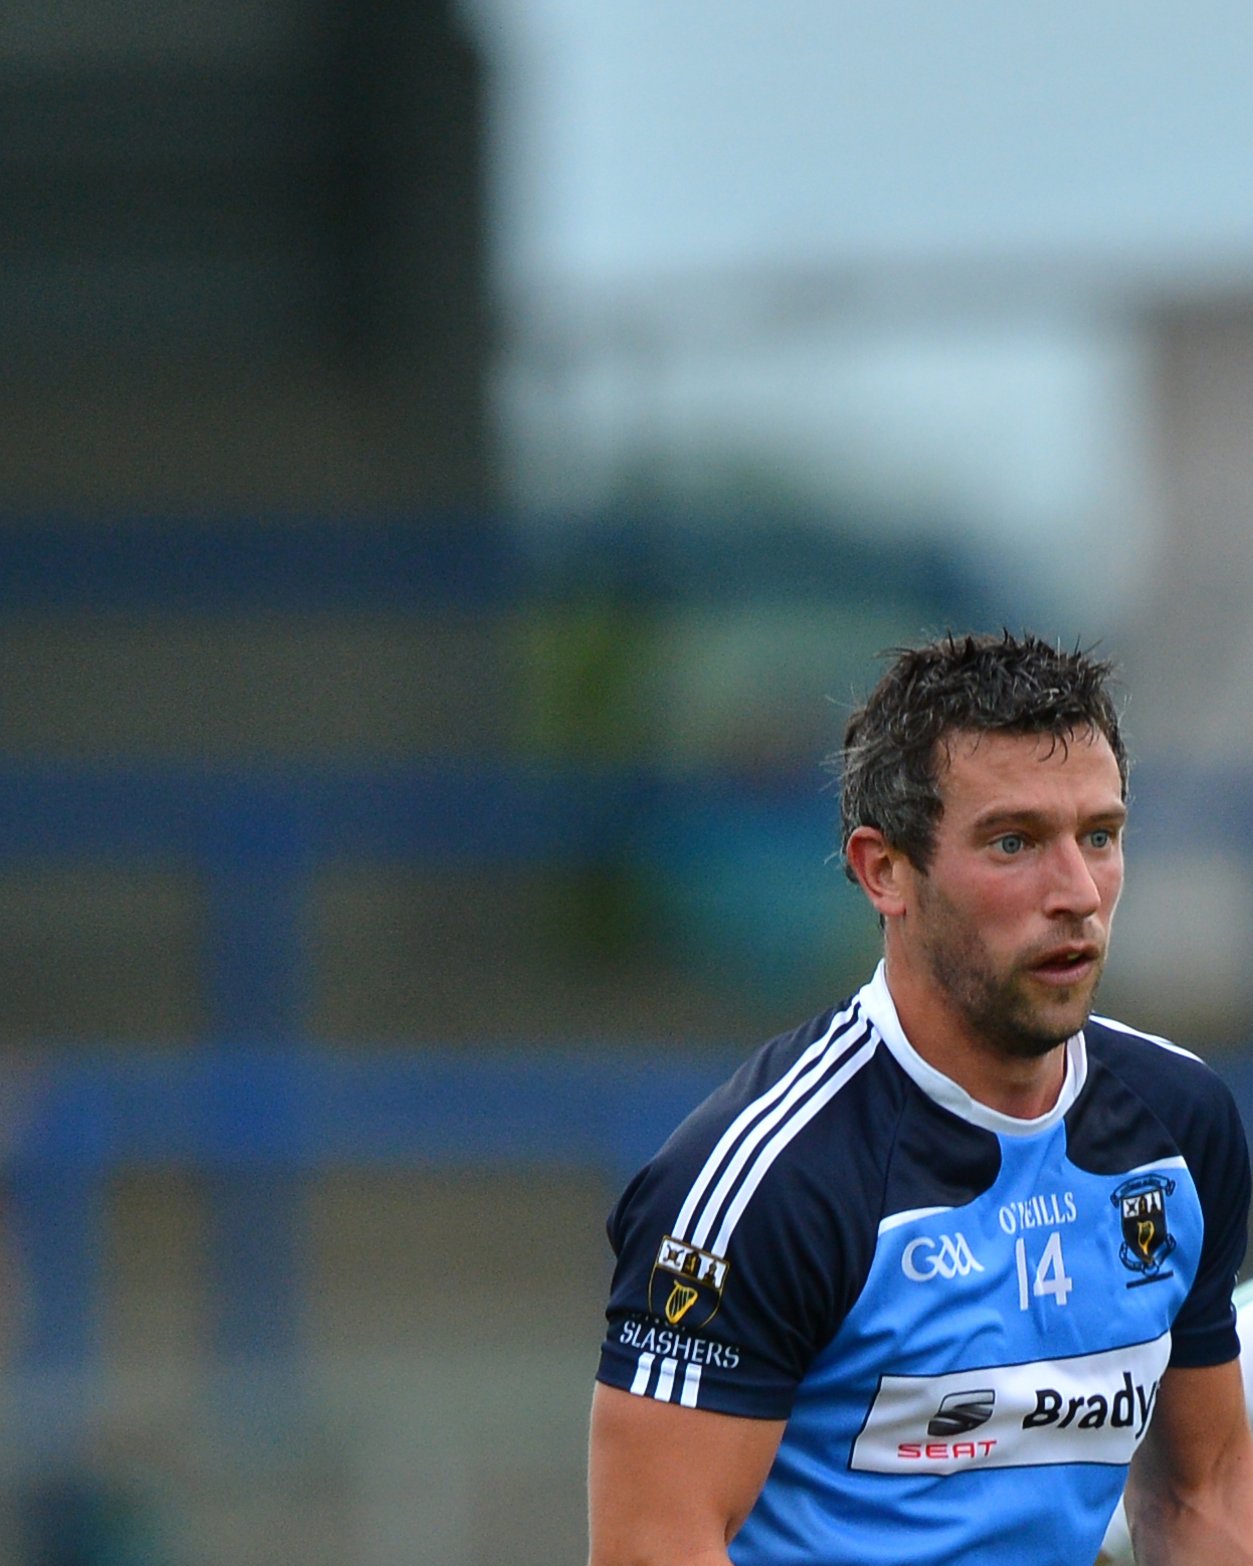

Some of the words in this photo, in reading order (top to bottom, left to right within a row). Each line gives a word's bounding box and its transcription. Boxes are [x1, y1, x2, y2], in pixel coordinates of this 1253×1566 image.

[999, 1192, 1077, 1235] O'NEILLS
[901, 1232, 985, 1282] GAA
[1015, 1231, 1073, 1312] 14
[619, 1319, 741, 1369] SLASHERS
[1022, 1371, 1157, 1440] Brady
[897, 1440, 997, 1458] SEAT
